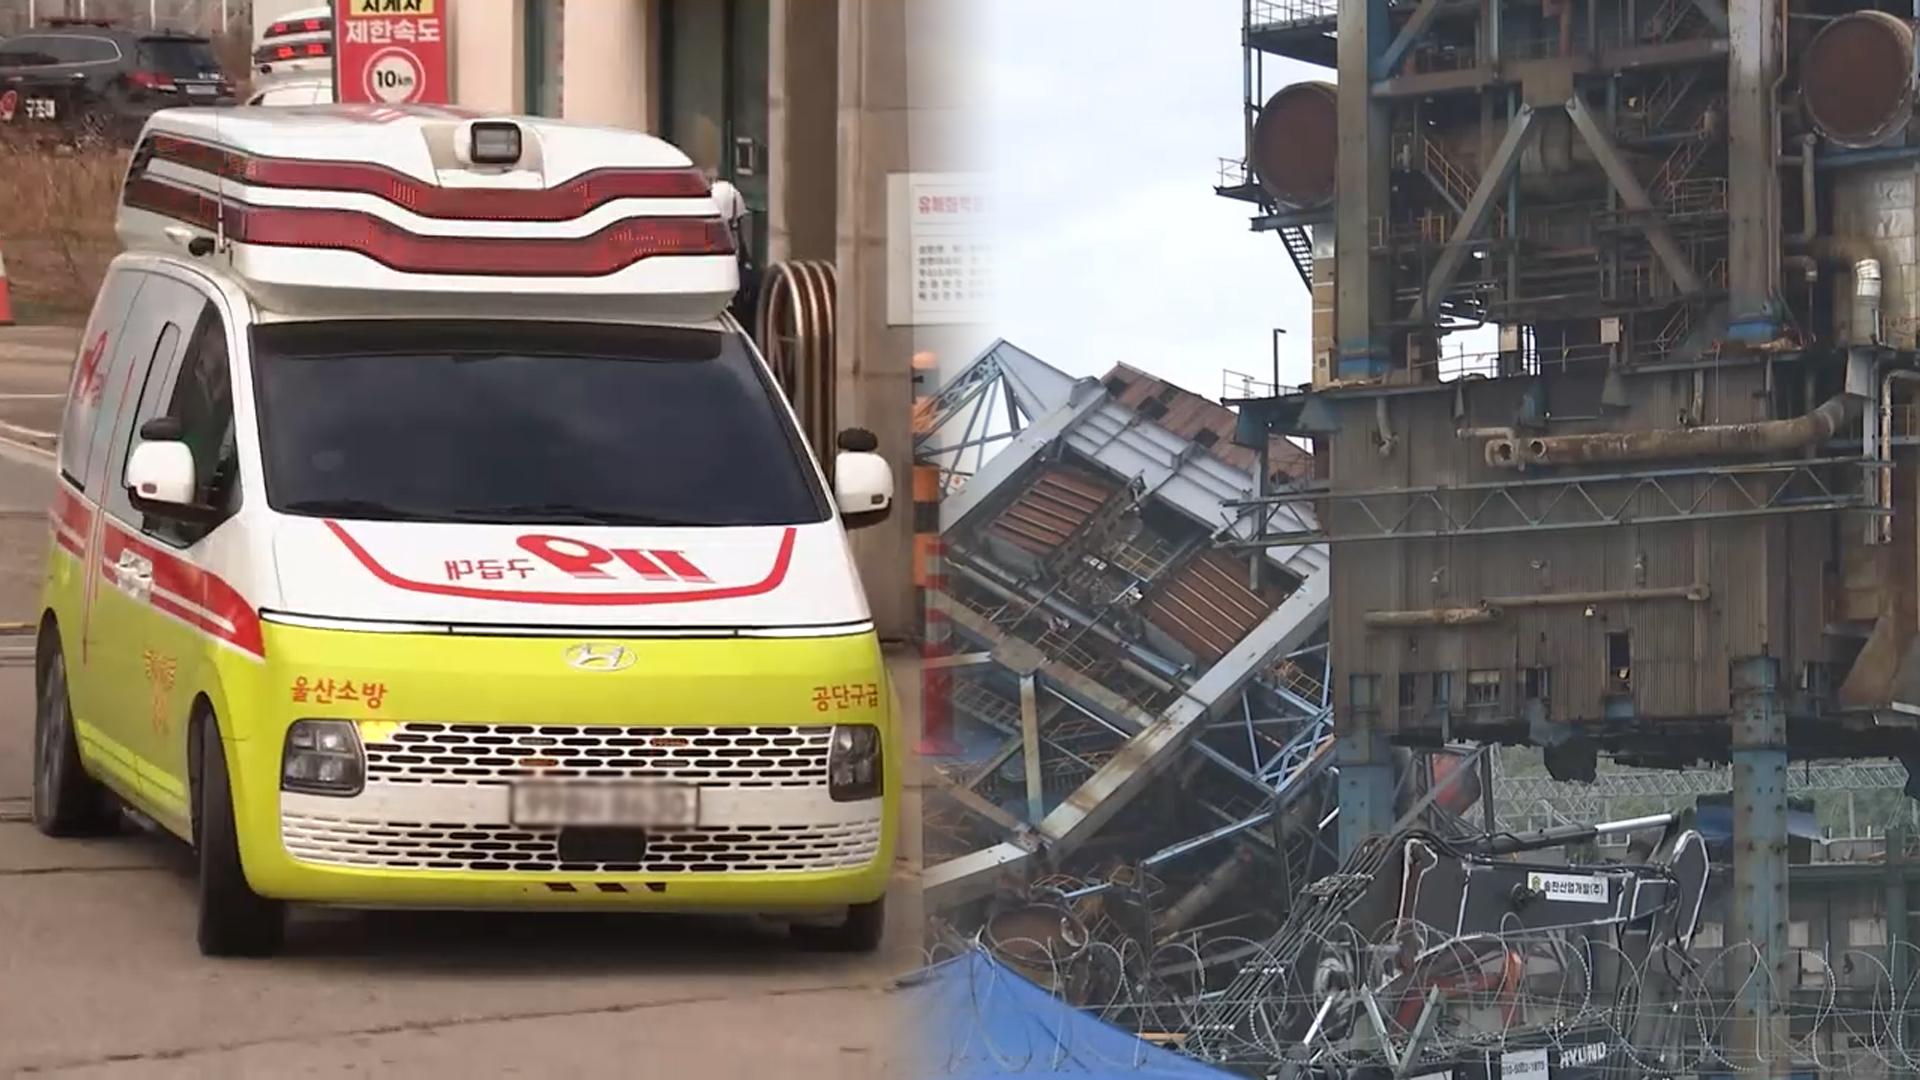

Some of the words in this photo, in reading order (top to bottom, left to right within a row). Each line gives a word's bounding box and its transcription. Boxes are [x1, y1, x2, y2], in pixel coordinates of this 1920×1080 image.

[345, 18, 440, 43] 제한속도
[291, 676, 388, 709] 울산소방
[812, 683, 878, 712] 공단구급
